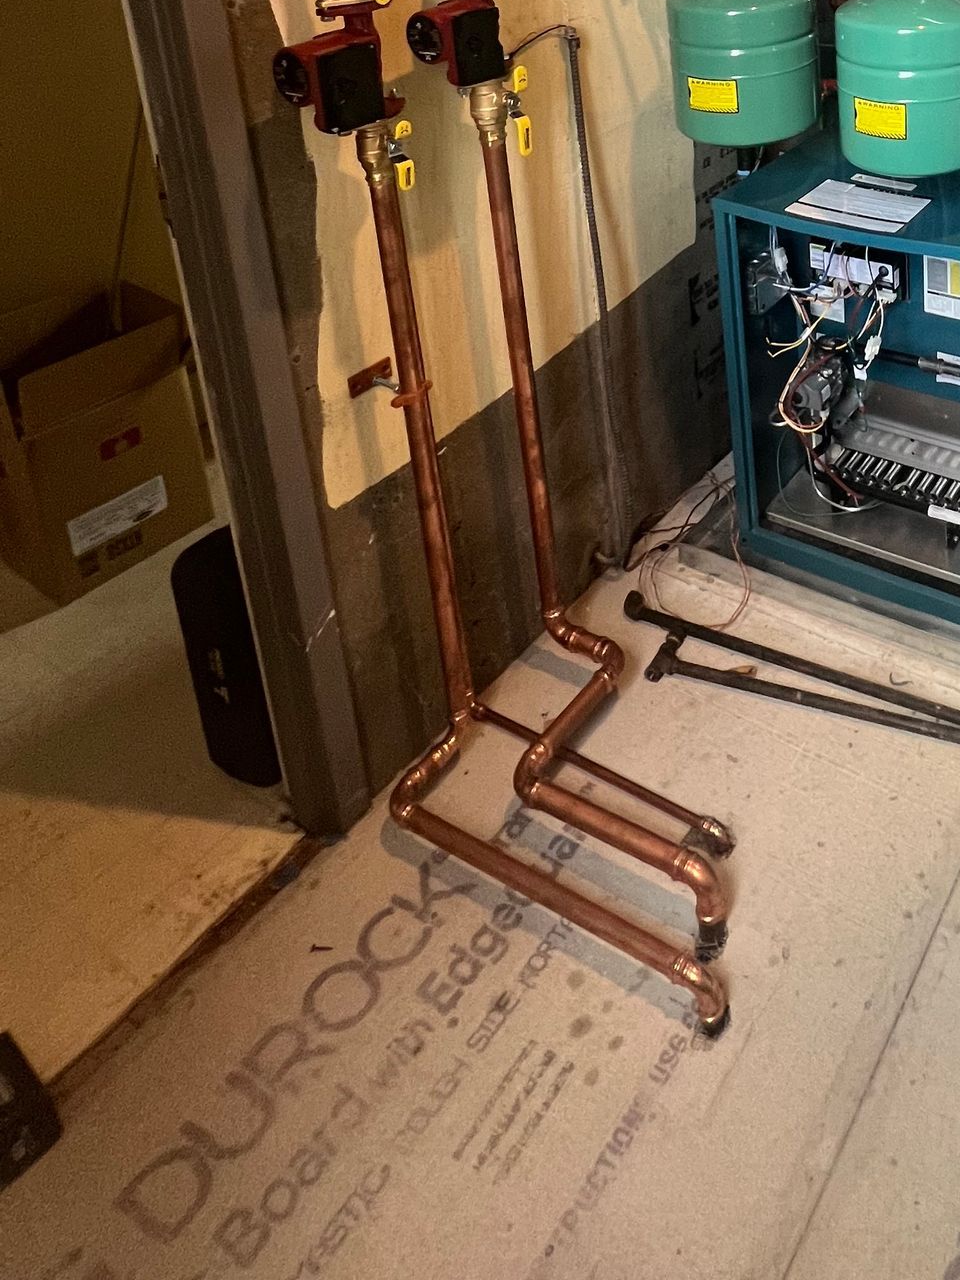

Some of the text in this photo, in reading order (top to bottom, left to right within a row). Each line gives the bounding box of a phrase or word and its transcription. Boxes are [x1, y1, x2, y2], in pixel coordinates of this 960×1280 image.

[465, 989, 520, 1054] SIDE
[211, 1017, 435, 1273] Board with
